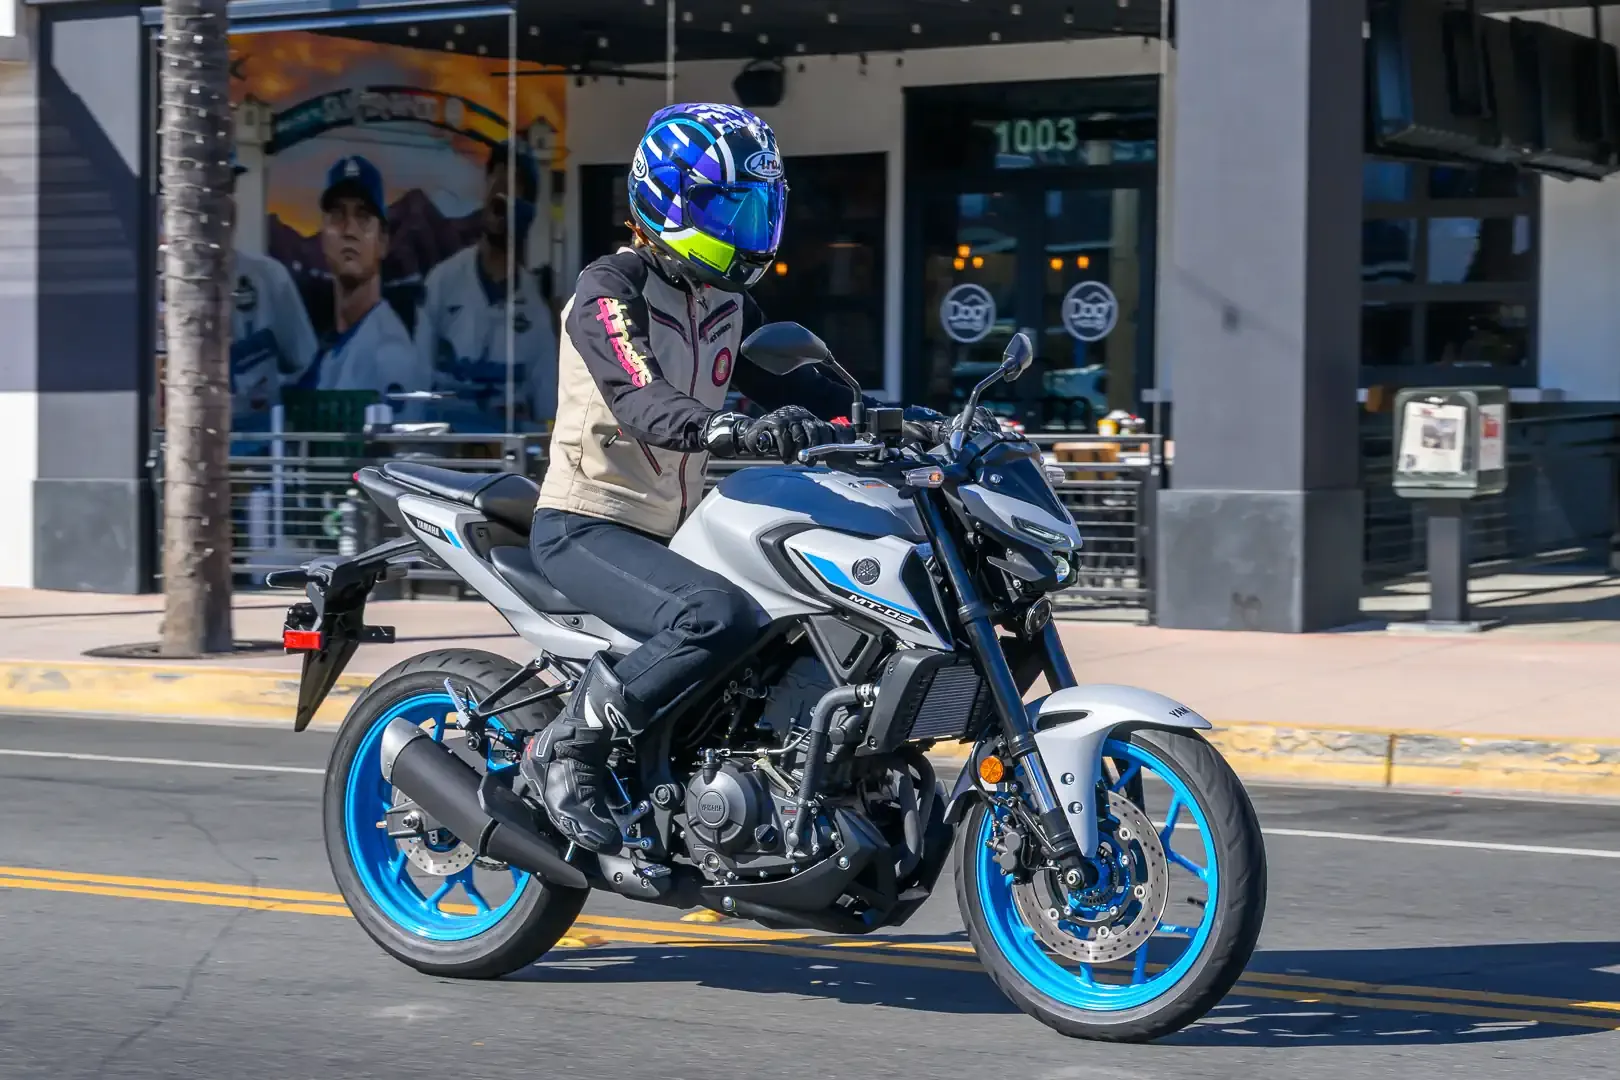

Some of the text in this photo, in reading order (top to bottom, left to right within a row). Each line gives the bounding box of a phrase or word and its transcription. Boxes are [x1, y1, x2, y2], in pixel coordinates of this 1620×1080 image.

[995, 117, 1078, 153] 1003
[416, 519, 440, 537] YAMAHA
[848, 594, 914, 624] MT-03
